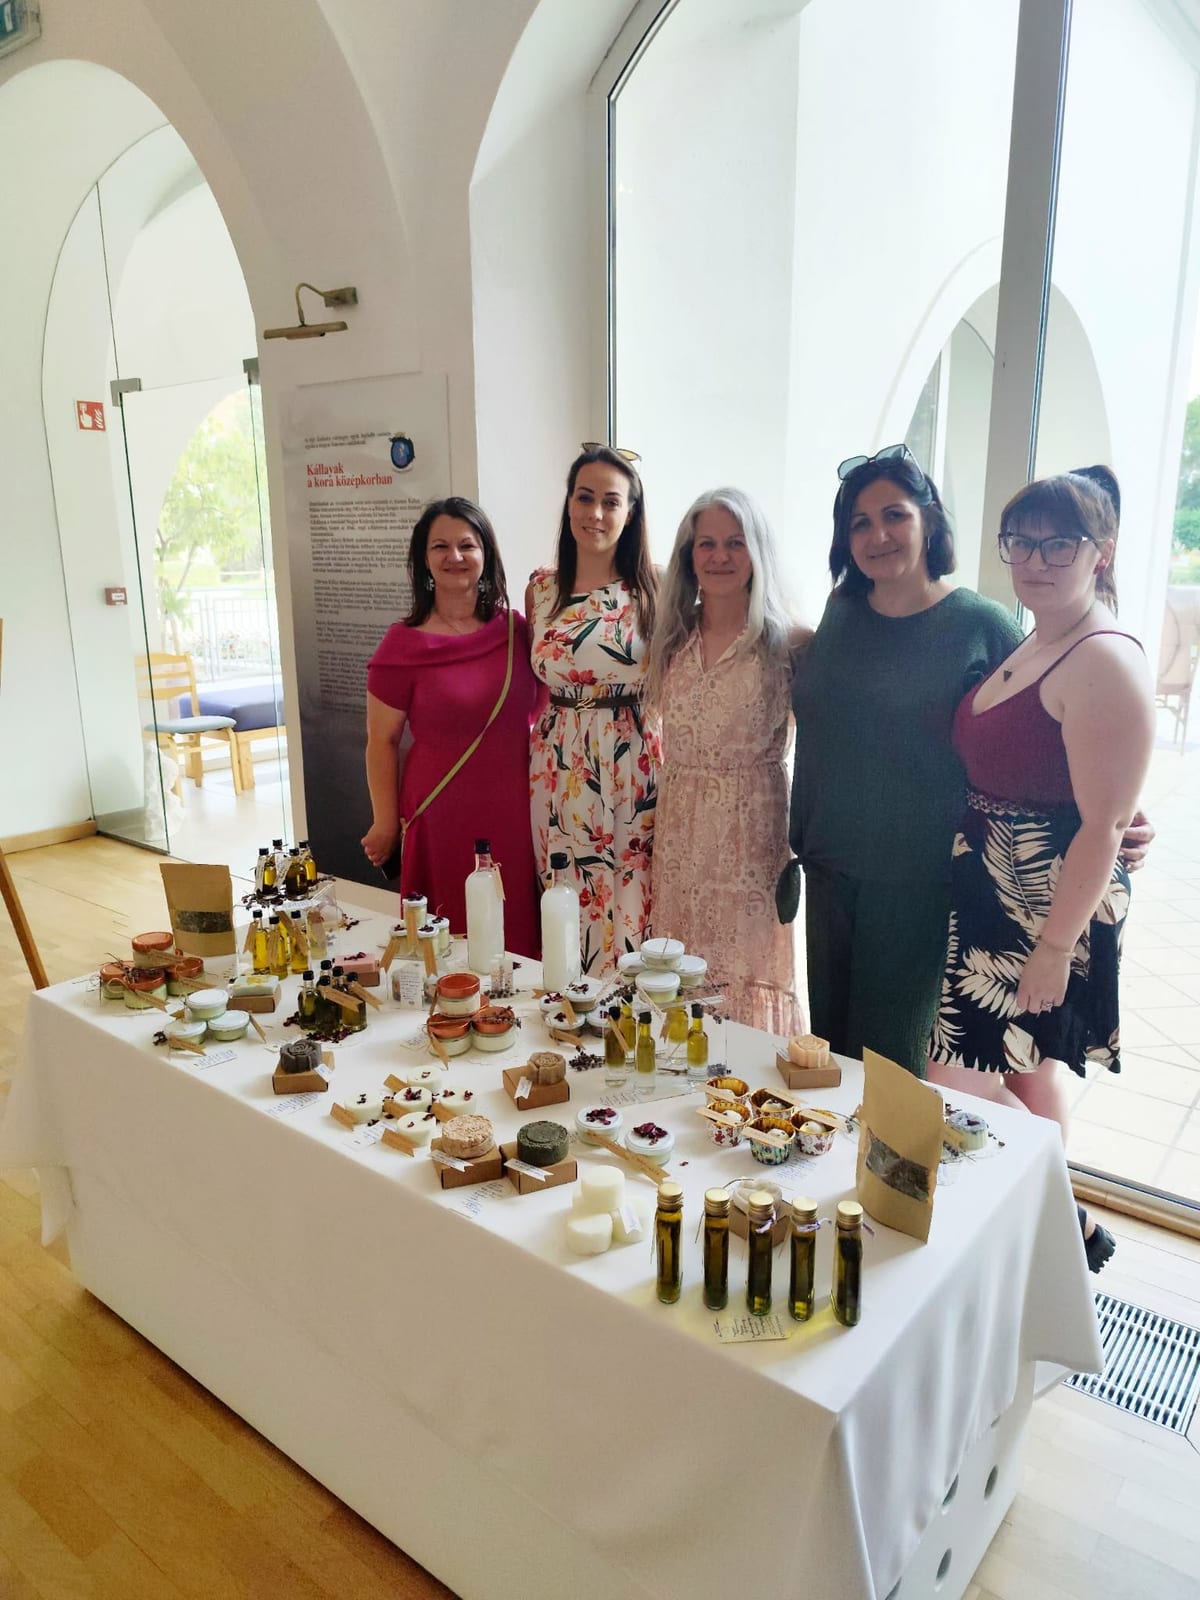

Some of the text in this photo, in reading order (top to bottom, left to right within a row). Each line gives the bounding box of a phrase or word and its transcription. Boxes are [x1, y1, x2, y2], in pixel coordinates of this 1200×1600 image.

[306, 463, 344, 477] Kállayak
[307, 473, 393, 488] a kora középkorban
